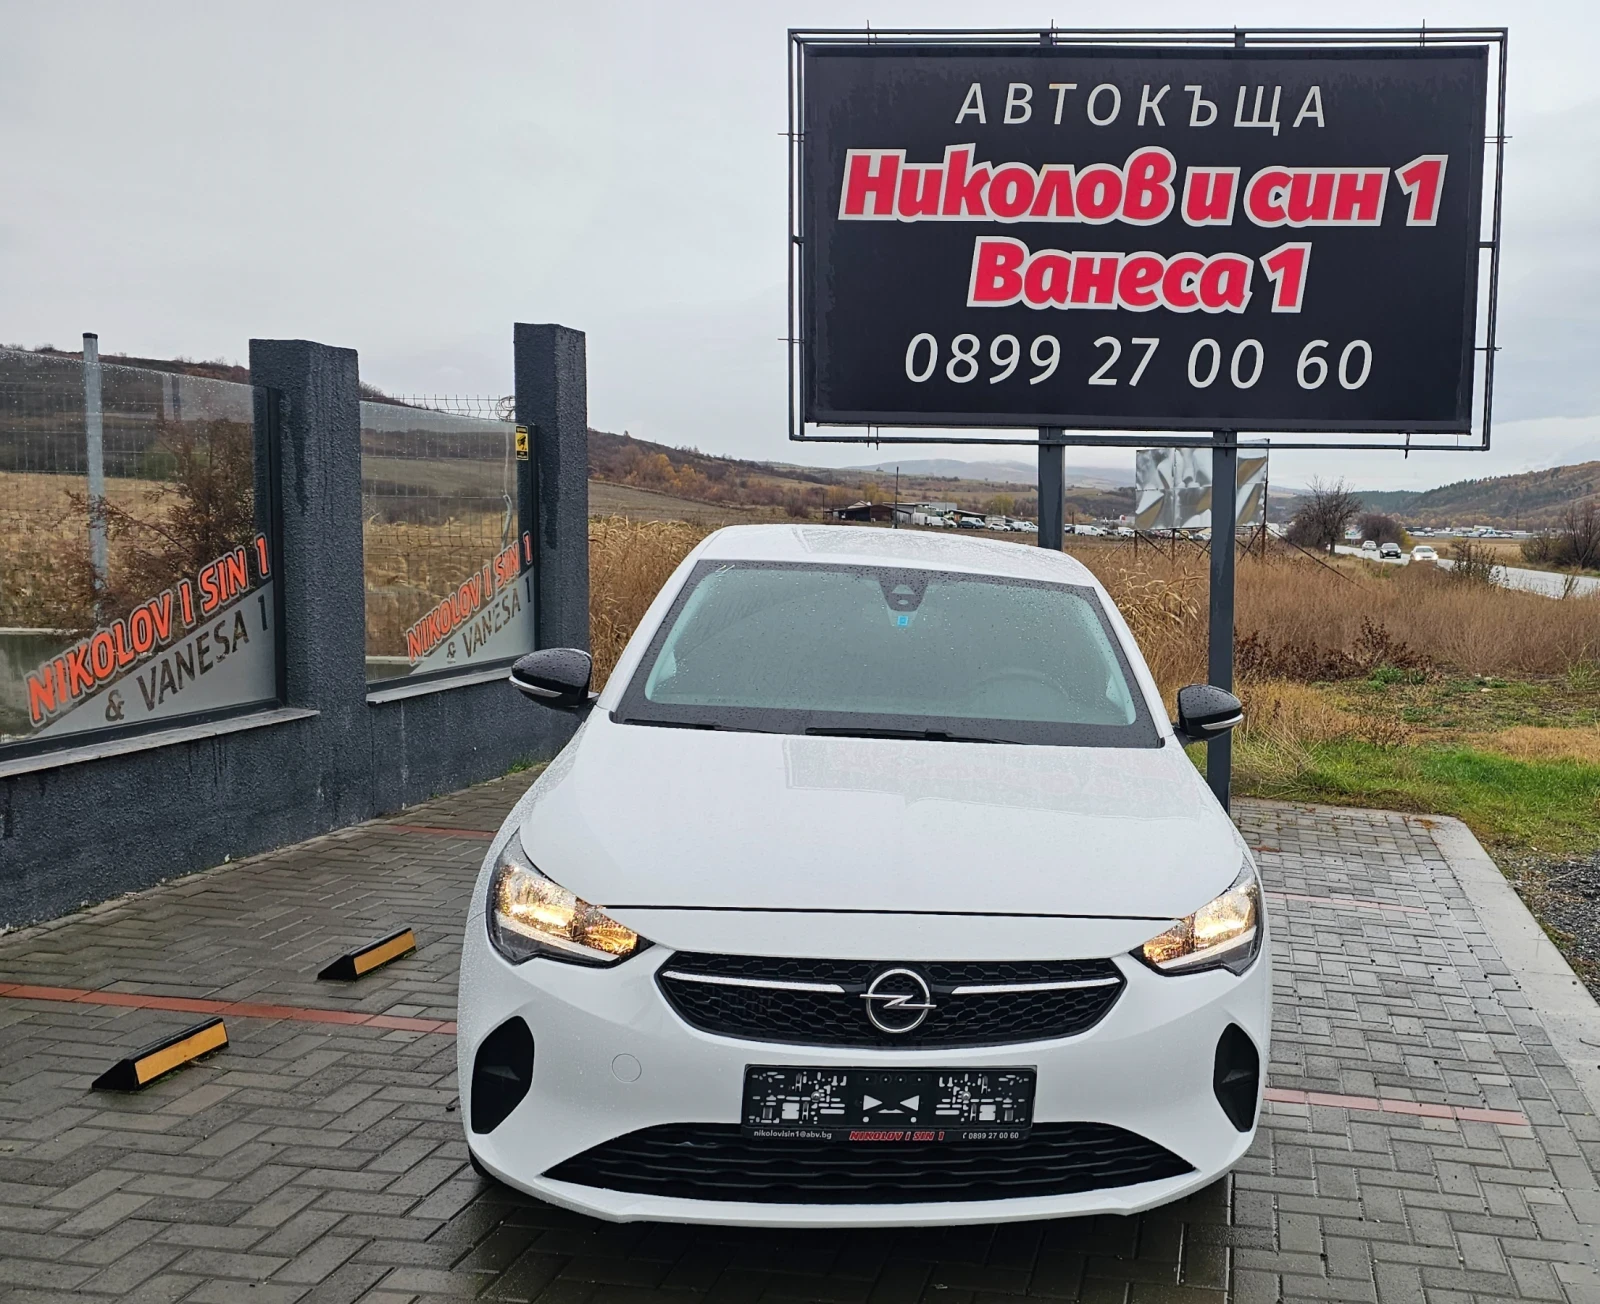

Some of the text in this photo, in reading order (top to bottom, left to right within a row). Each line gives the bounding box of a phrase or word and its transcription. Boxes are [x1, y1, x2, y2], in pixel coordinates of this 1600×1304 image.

[955, 81, 1326, 136] АВТОКЪЩА
[838, 142, 1448, 227] Николов и син 1
[967, 235, 1311, 314] Ванеса 1
[905, 332, 1373, 390] 0899 27 00 60
[25, 532, 270, 727] NIKOLOV I SIN 1
[406, 531, 532, 666] NIKOLOV I SIN 1
[462, 588, 521, 657] VANESA
[525, 576, 531, 603] 1
[105, 595, 268, 721] & VANESA 1
[849, 1131, 903, 1141] NIKOLOV
[912, 1131, 935, 1141] SIN
[938, 1131, 945, 1141] 1
[968, 1132, 986, 1140] 0899
